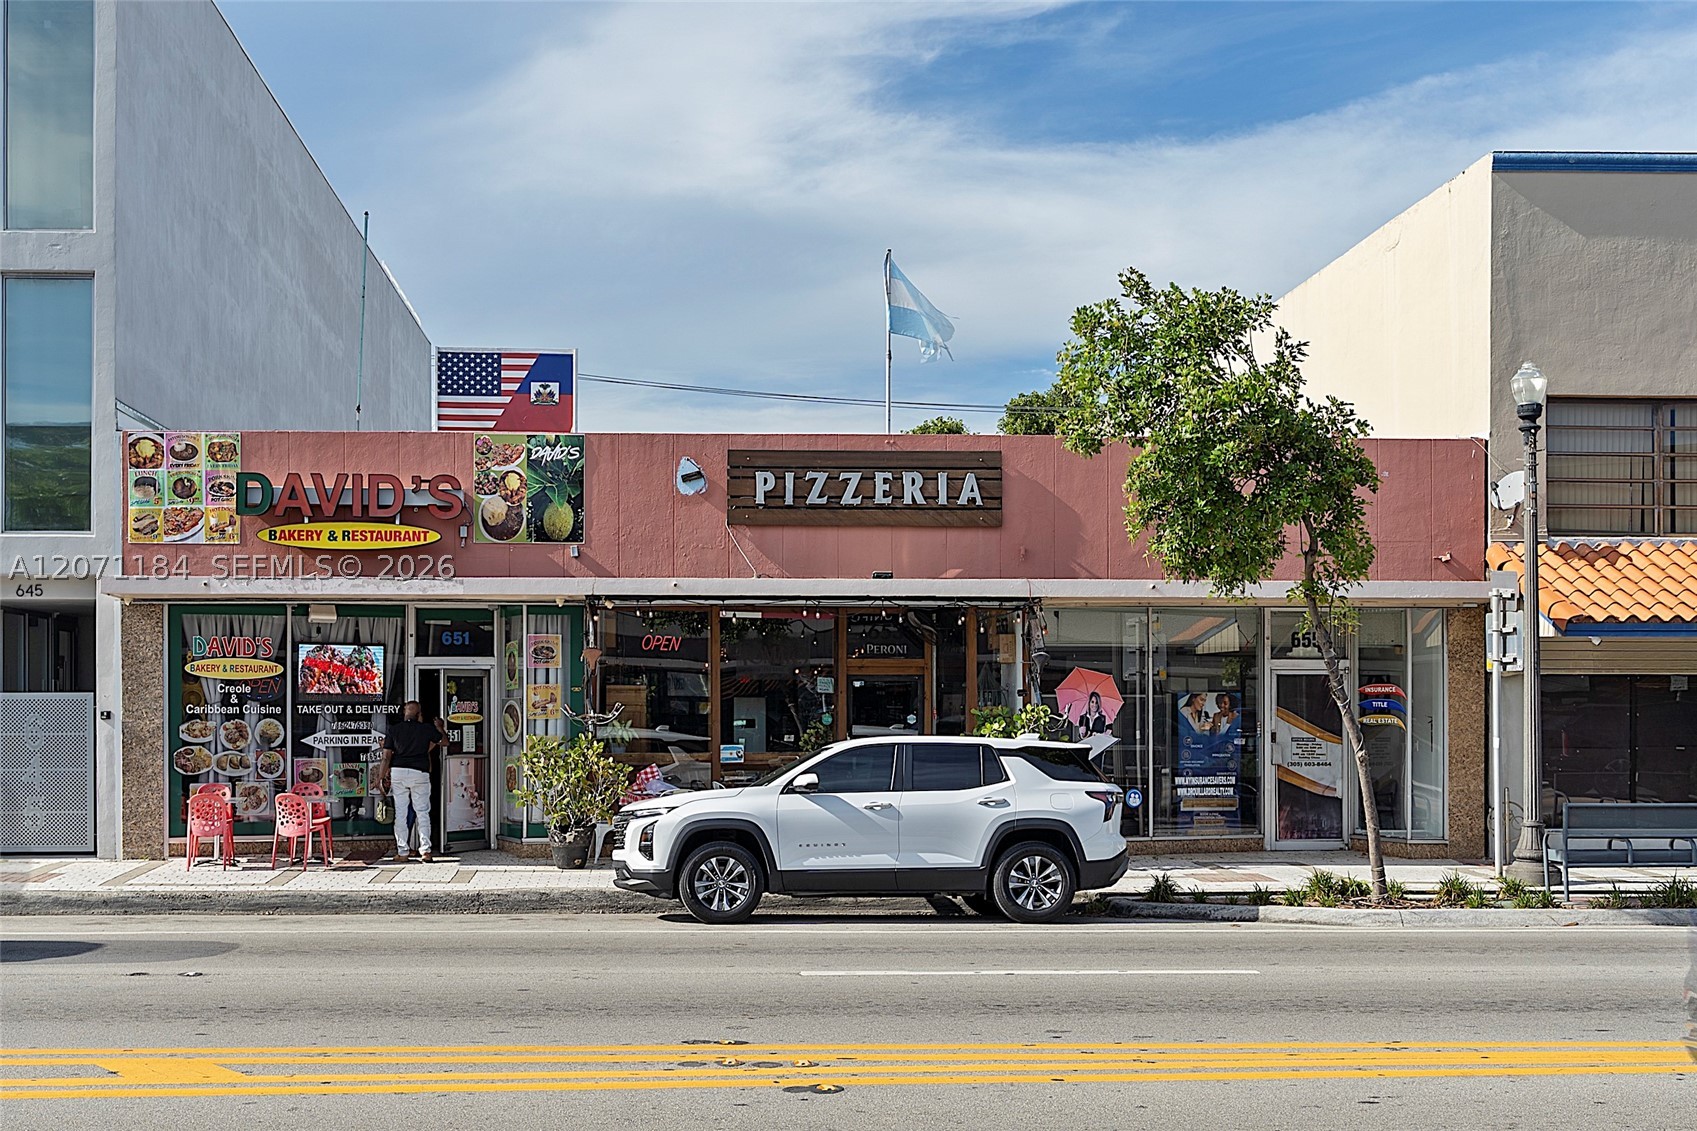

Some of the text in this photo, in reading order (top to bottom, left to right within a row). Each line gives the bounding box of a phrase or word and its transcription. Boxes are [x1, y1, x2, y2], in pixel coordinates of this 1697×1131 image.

[529, 441, 580, 466] DAVID'S
[755, 470, 983, 505] PIZZERIA
[236, 472, 463, 519] DAVID'S
[268, 529, 430, 542] BAKERY & RESTAURANT
[15, 583, 43, 597] 645
[442, 631, 470, 645] 651
[641, 634, 682, 652] OPEN
[192, 635, 274, 658] DAVID'S
[866, 643, 907, 654] PERONI
[190, 664, 279, 674] BAKERY & RESTAURANT
[217, 683, 252, 693] Creole
[229, 694, 239, 704] &
[186, 704, 282, 714] Caribbean Cuisine
[297, 705, 401, 714] TAKE OUT & DELIVERY
[313, 736, 350, 745] PARKING
[351, 736, 360, 745] IN
